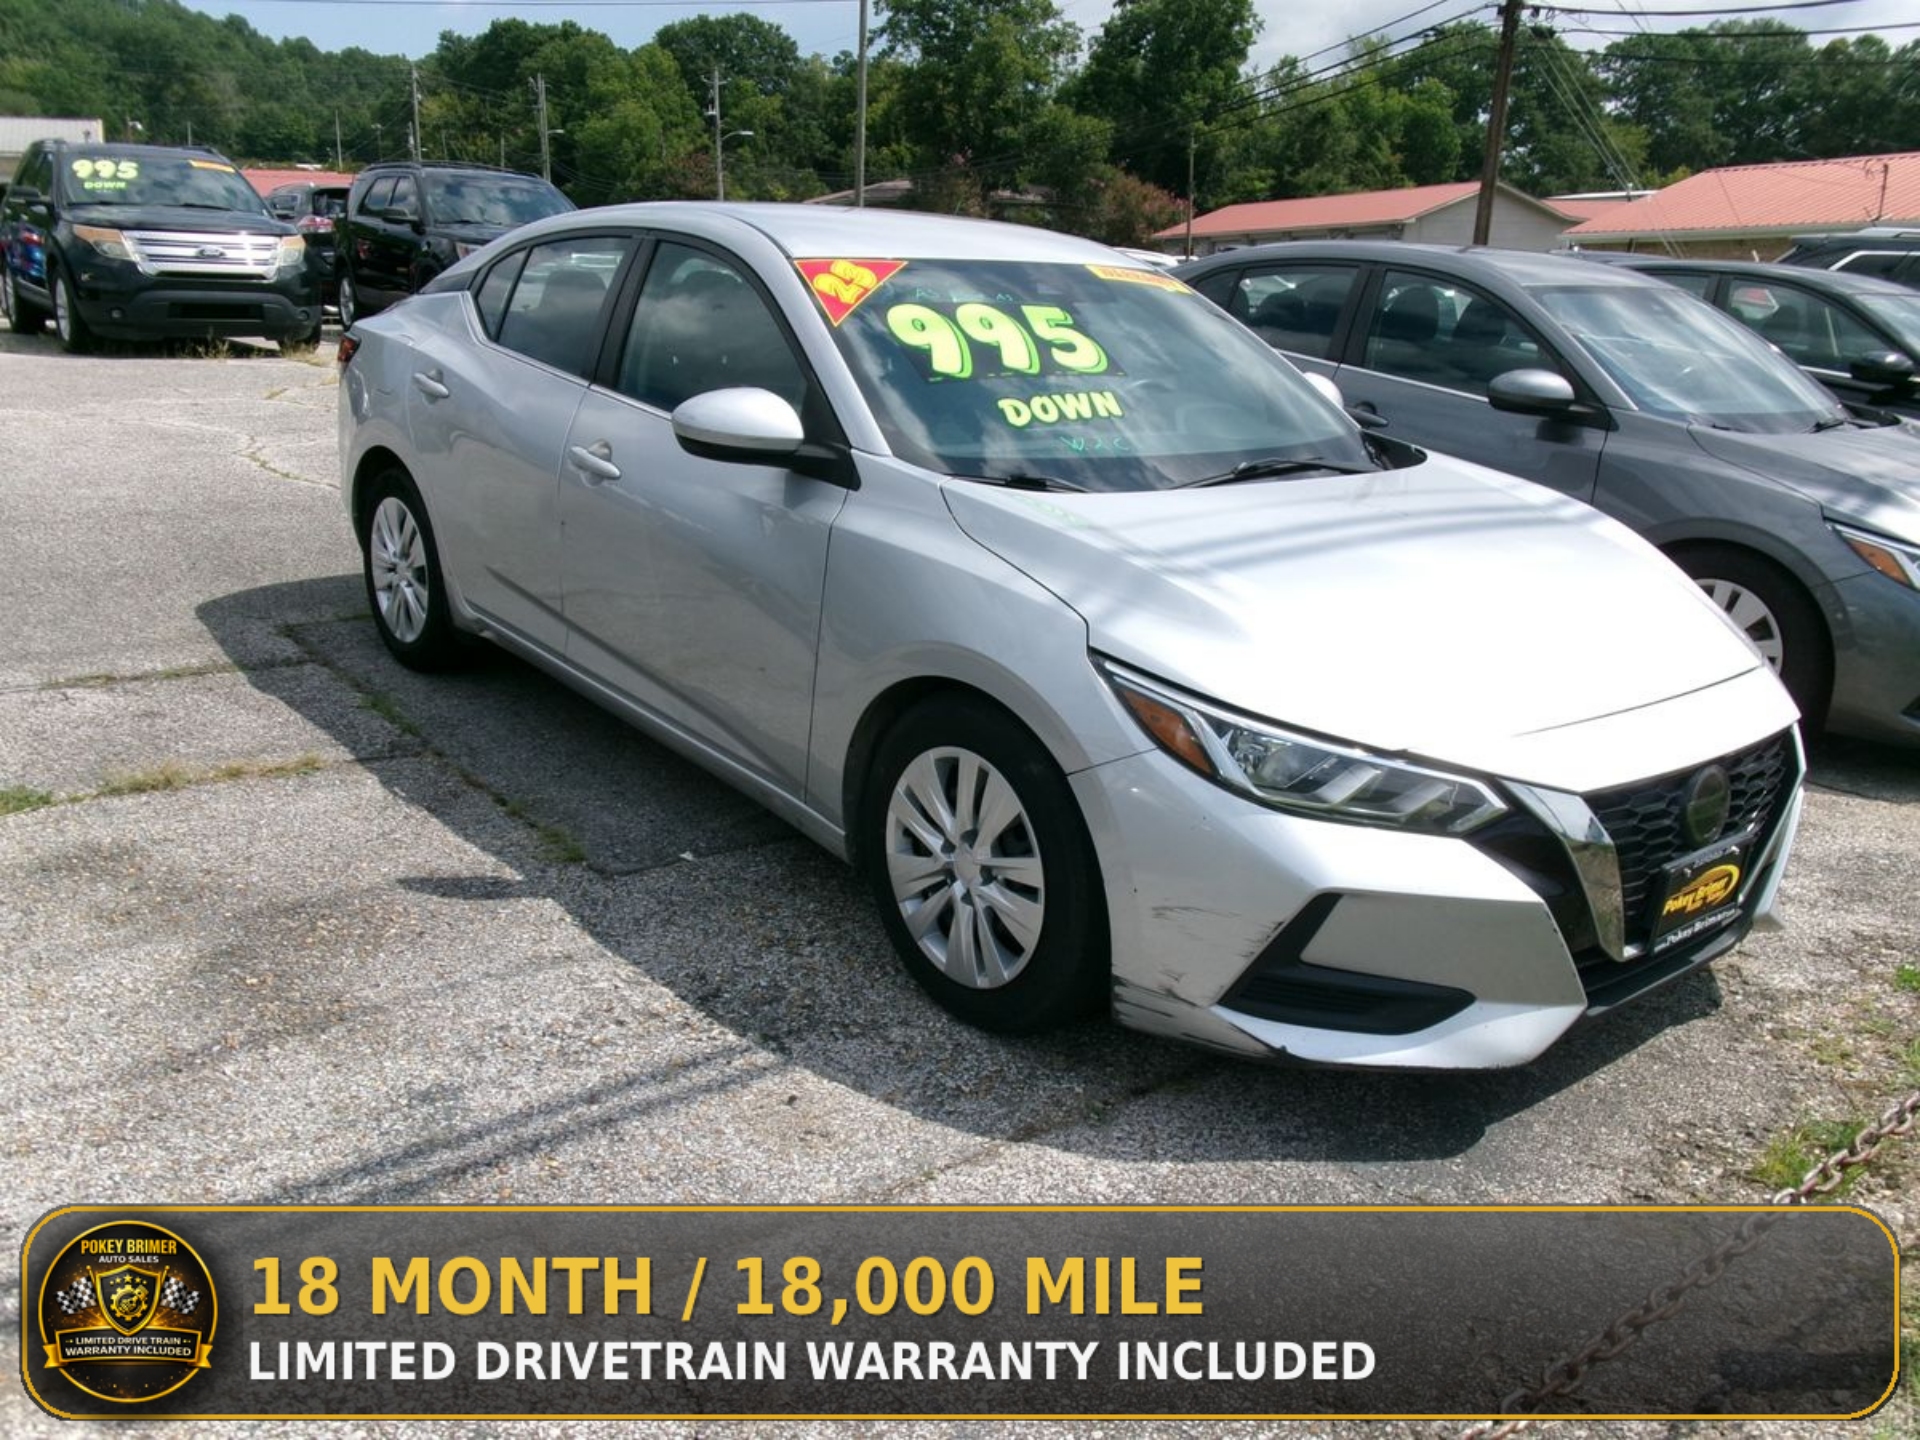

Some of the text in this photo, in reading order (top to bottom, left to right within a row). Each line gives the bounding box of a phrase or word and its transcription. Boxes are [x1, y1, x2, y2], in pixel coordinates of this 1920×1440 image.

[71, 158, 139, 180] 995
[83, 181, 126, 190] DOWN
[886, 303, 1109, 380] 995
[998, 391, 1123, 430] DOWN
